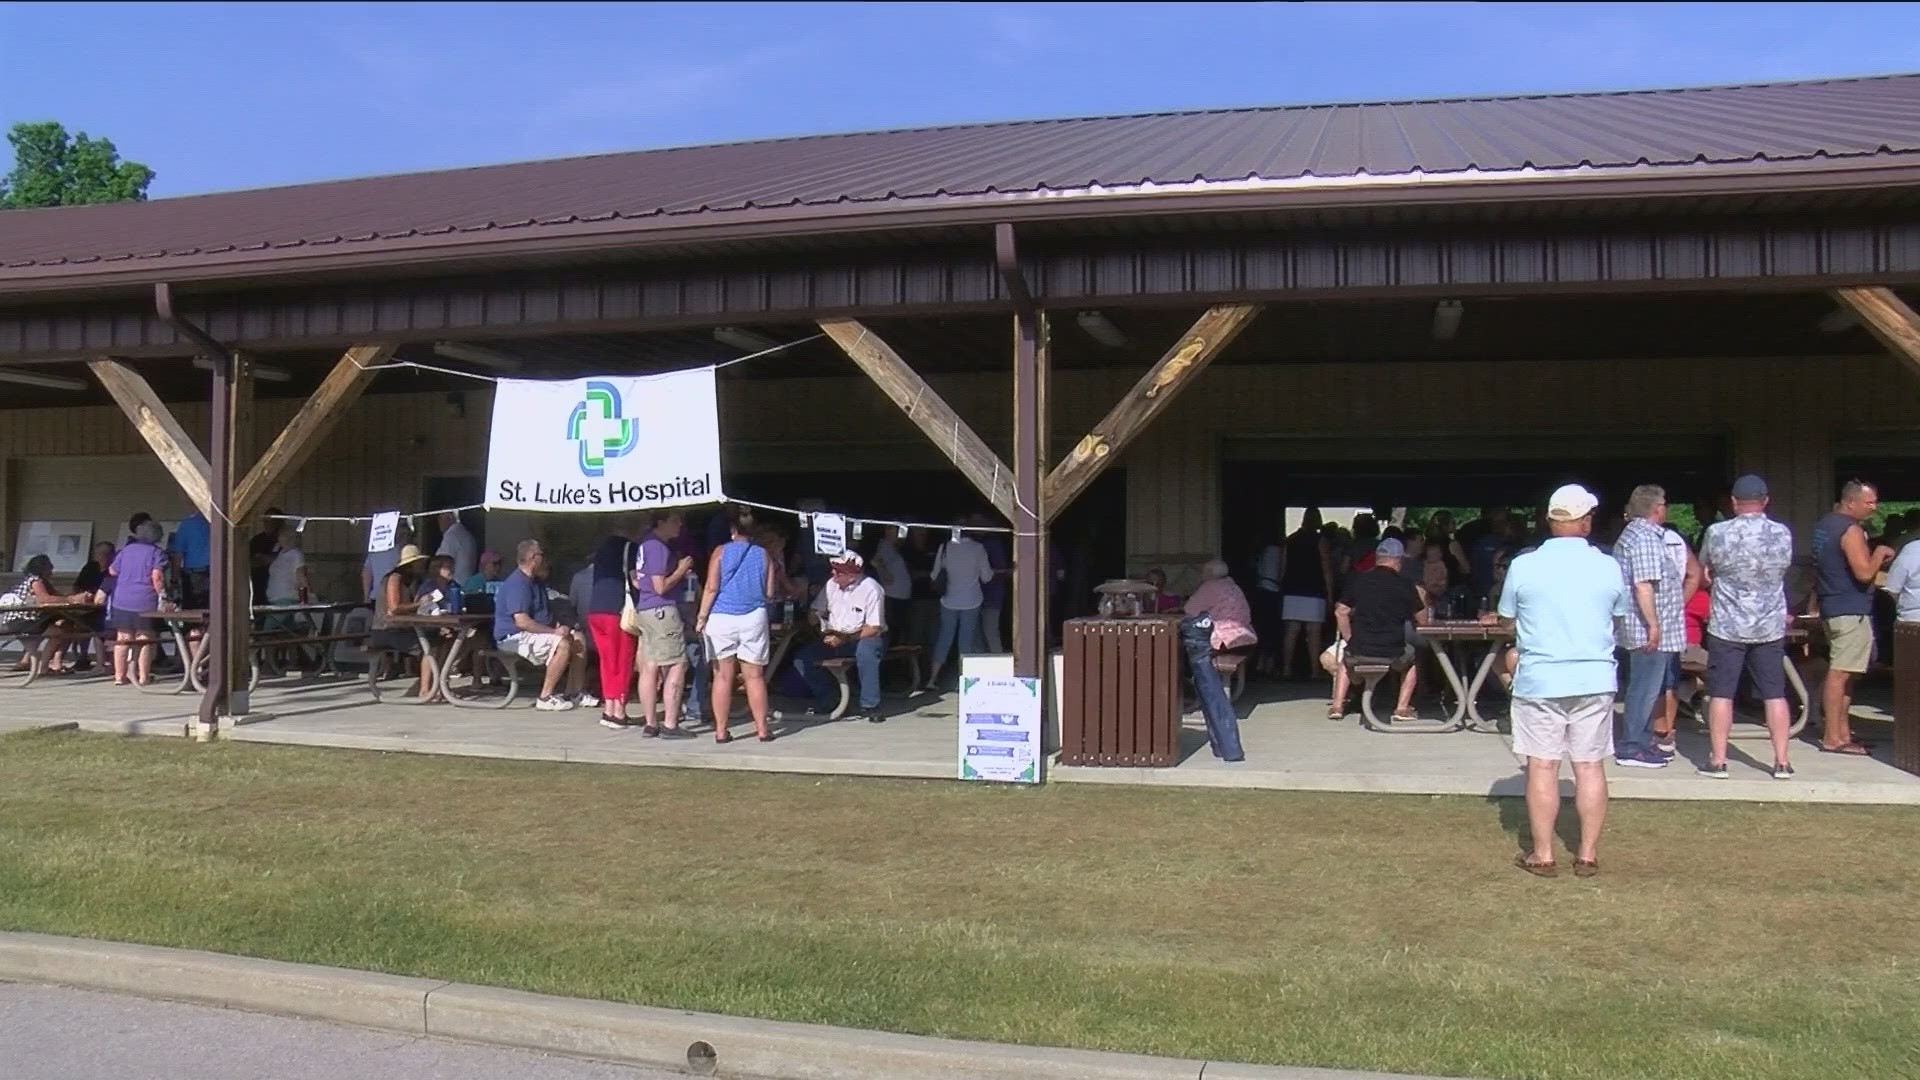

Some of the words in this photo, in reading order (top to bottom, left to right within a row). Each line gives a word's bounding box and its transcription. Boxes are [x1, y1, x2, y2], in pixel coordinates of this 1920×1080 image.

[499, 480, 527, 503] St.
[534, 481, 602, 505] Luke's
[608, 473, 711, 504] Hospital
